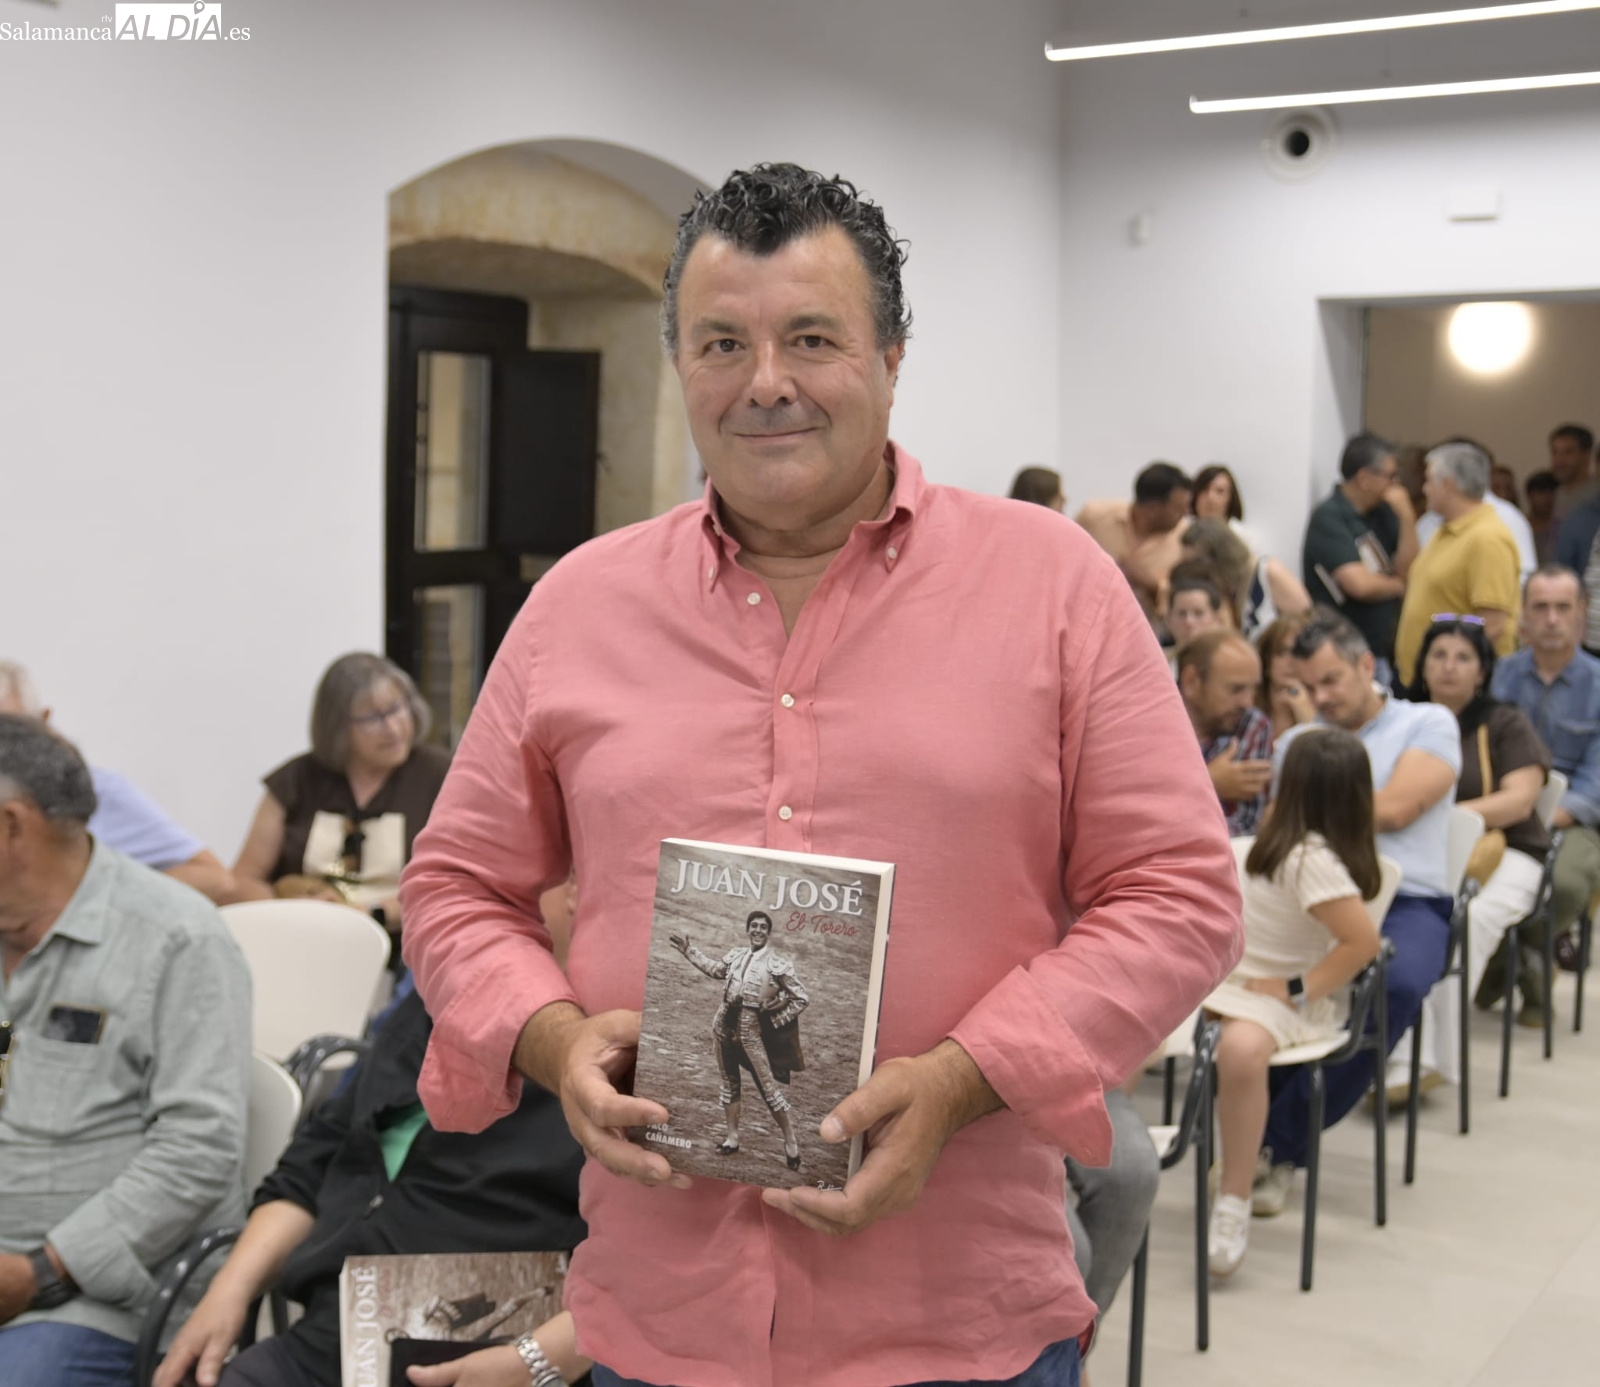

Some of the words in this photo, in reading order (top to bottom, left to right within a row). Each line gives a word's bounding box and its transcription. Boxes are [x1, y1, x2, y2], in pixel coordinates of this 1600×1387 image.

[671, 858, 766, 900] JUAN
[769, 875, 864, 916] JOSÉ
[786, 911, 806, 931] El
[811, 914, 858, 937] Torero
[645, 1131, 692, 1149] CAÑAMERO
[350, 1265, 380, 1332] JOSÉ
[356, 1337, 379, 1387] UAN
